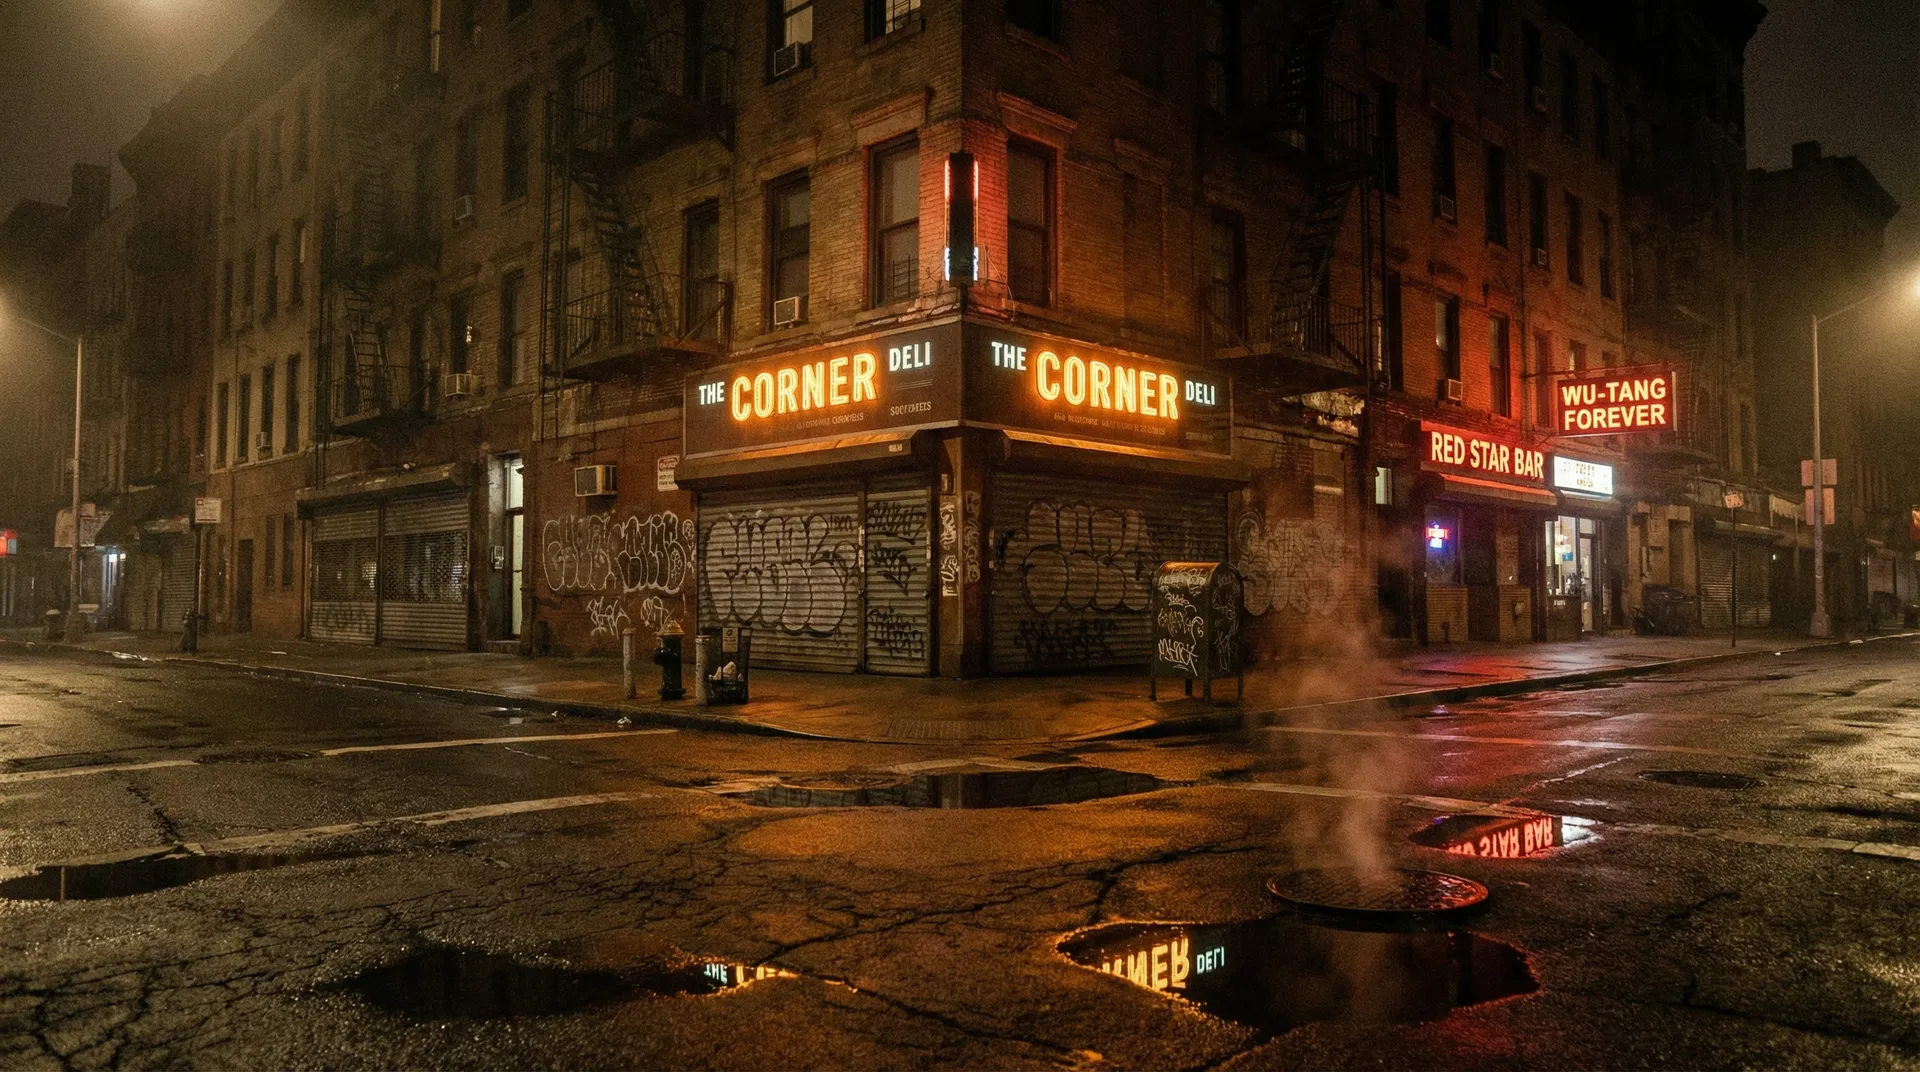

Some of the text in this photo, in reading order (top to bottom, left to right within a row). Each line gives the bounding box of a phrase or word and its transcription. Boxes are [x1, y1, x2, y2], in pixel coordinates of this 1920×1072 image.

[699, 381, 725, 405] THE
[731, 352, 878, 422] CORNER
[889, 341, 931, 372] DELI
[991, 341, 1216, 420] THE CORNER DELI
[1562, 378, 1667, 406] WU-TANG
[1564, 404, 1666, 431] FOREVER
[1431, 431, 1466, 465] RED
[1470, 440, 1510, 474] STAR
[1514, 447, 1544, 478] BAR
